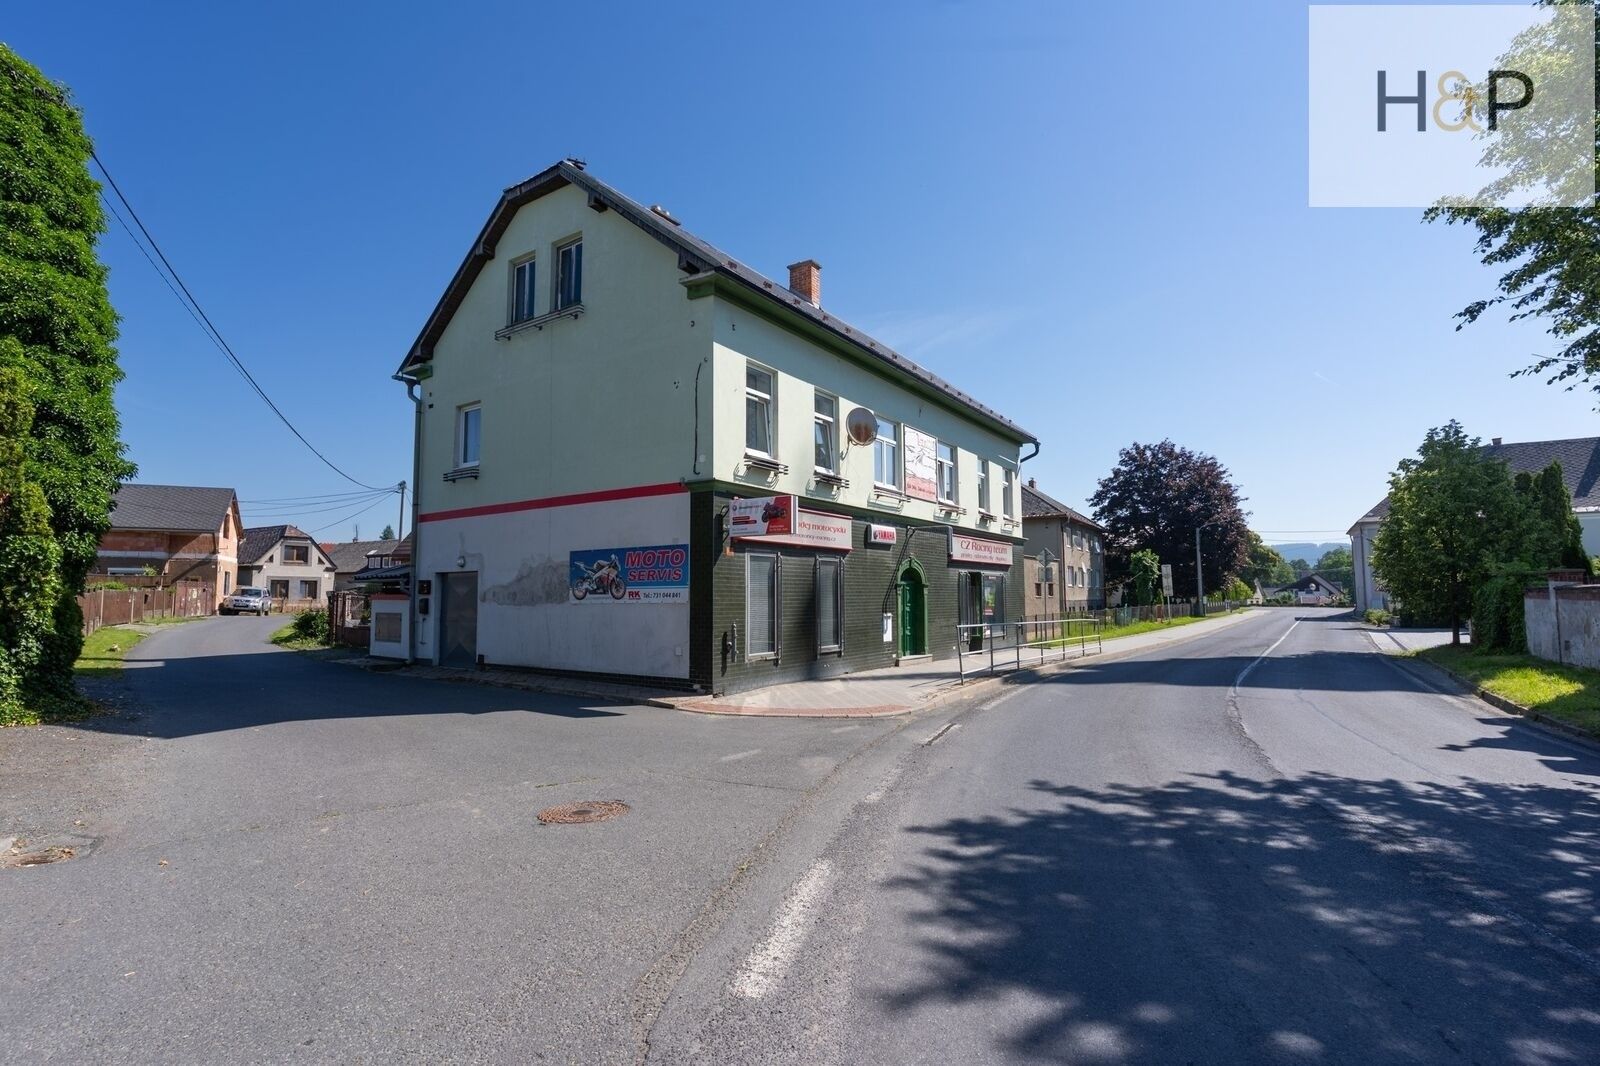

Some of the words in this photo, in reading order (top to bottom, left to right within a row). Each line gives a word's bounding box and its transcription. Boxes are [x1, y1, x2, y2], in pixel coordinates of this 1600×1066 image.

[878, 530, 895, 540] YAMAHA
[960, 540, 971, 550] CZ
[971, 541, 993, 554] Racing
[993, 545, 1008, 554] team
[625, 549, 686, 568] MOTO
[628, 568, 682, 582] SERVIS
